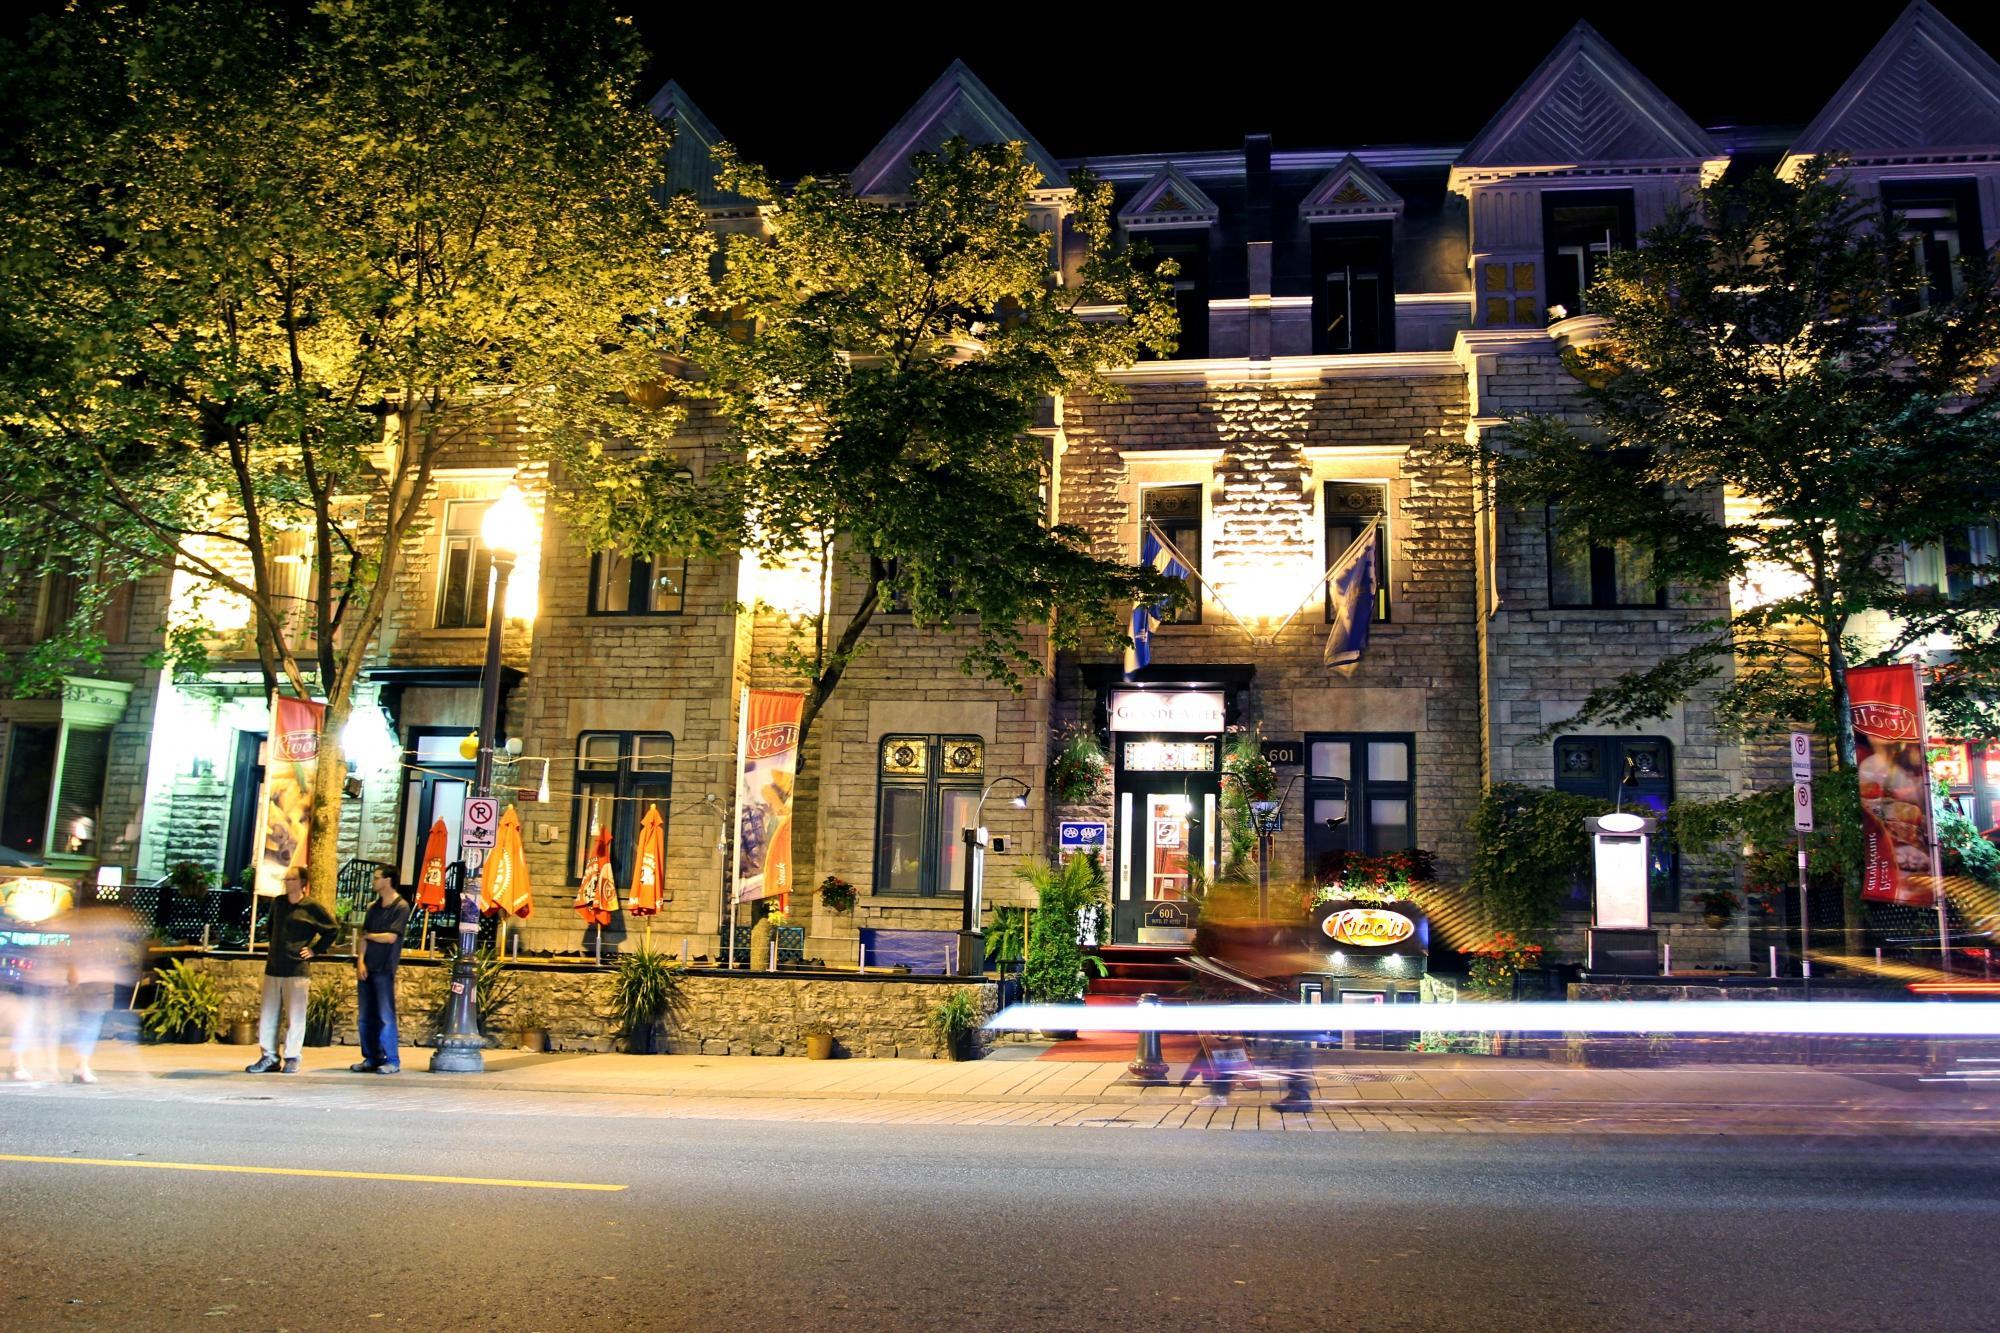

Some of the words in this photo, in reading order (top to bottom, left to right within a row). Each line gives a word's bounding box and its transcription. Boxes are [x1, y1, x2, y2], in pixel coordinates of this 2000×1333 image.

[746, 728, 797, 757] Rivoli
[1269, 750, 1294, 762] 601
[1159, 908, 1174, 919] 601
[1328, 911, 1408, 944] Rivoli
